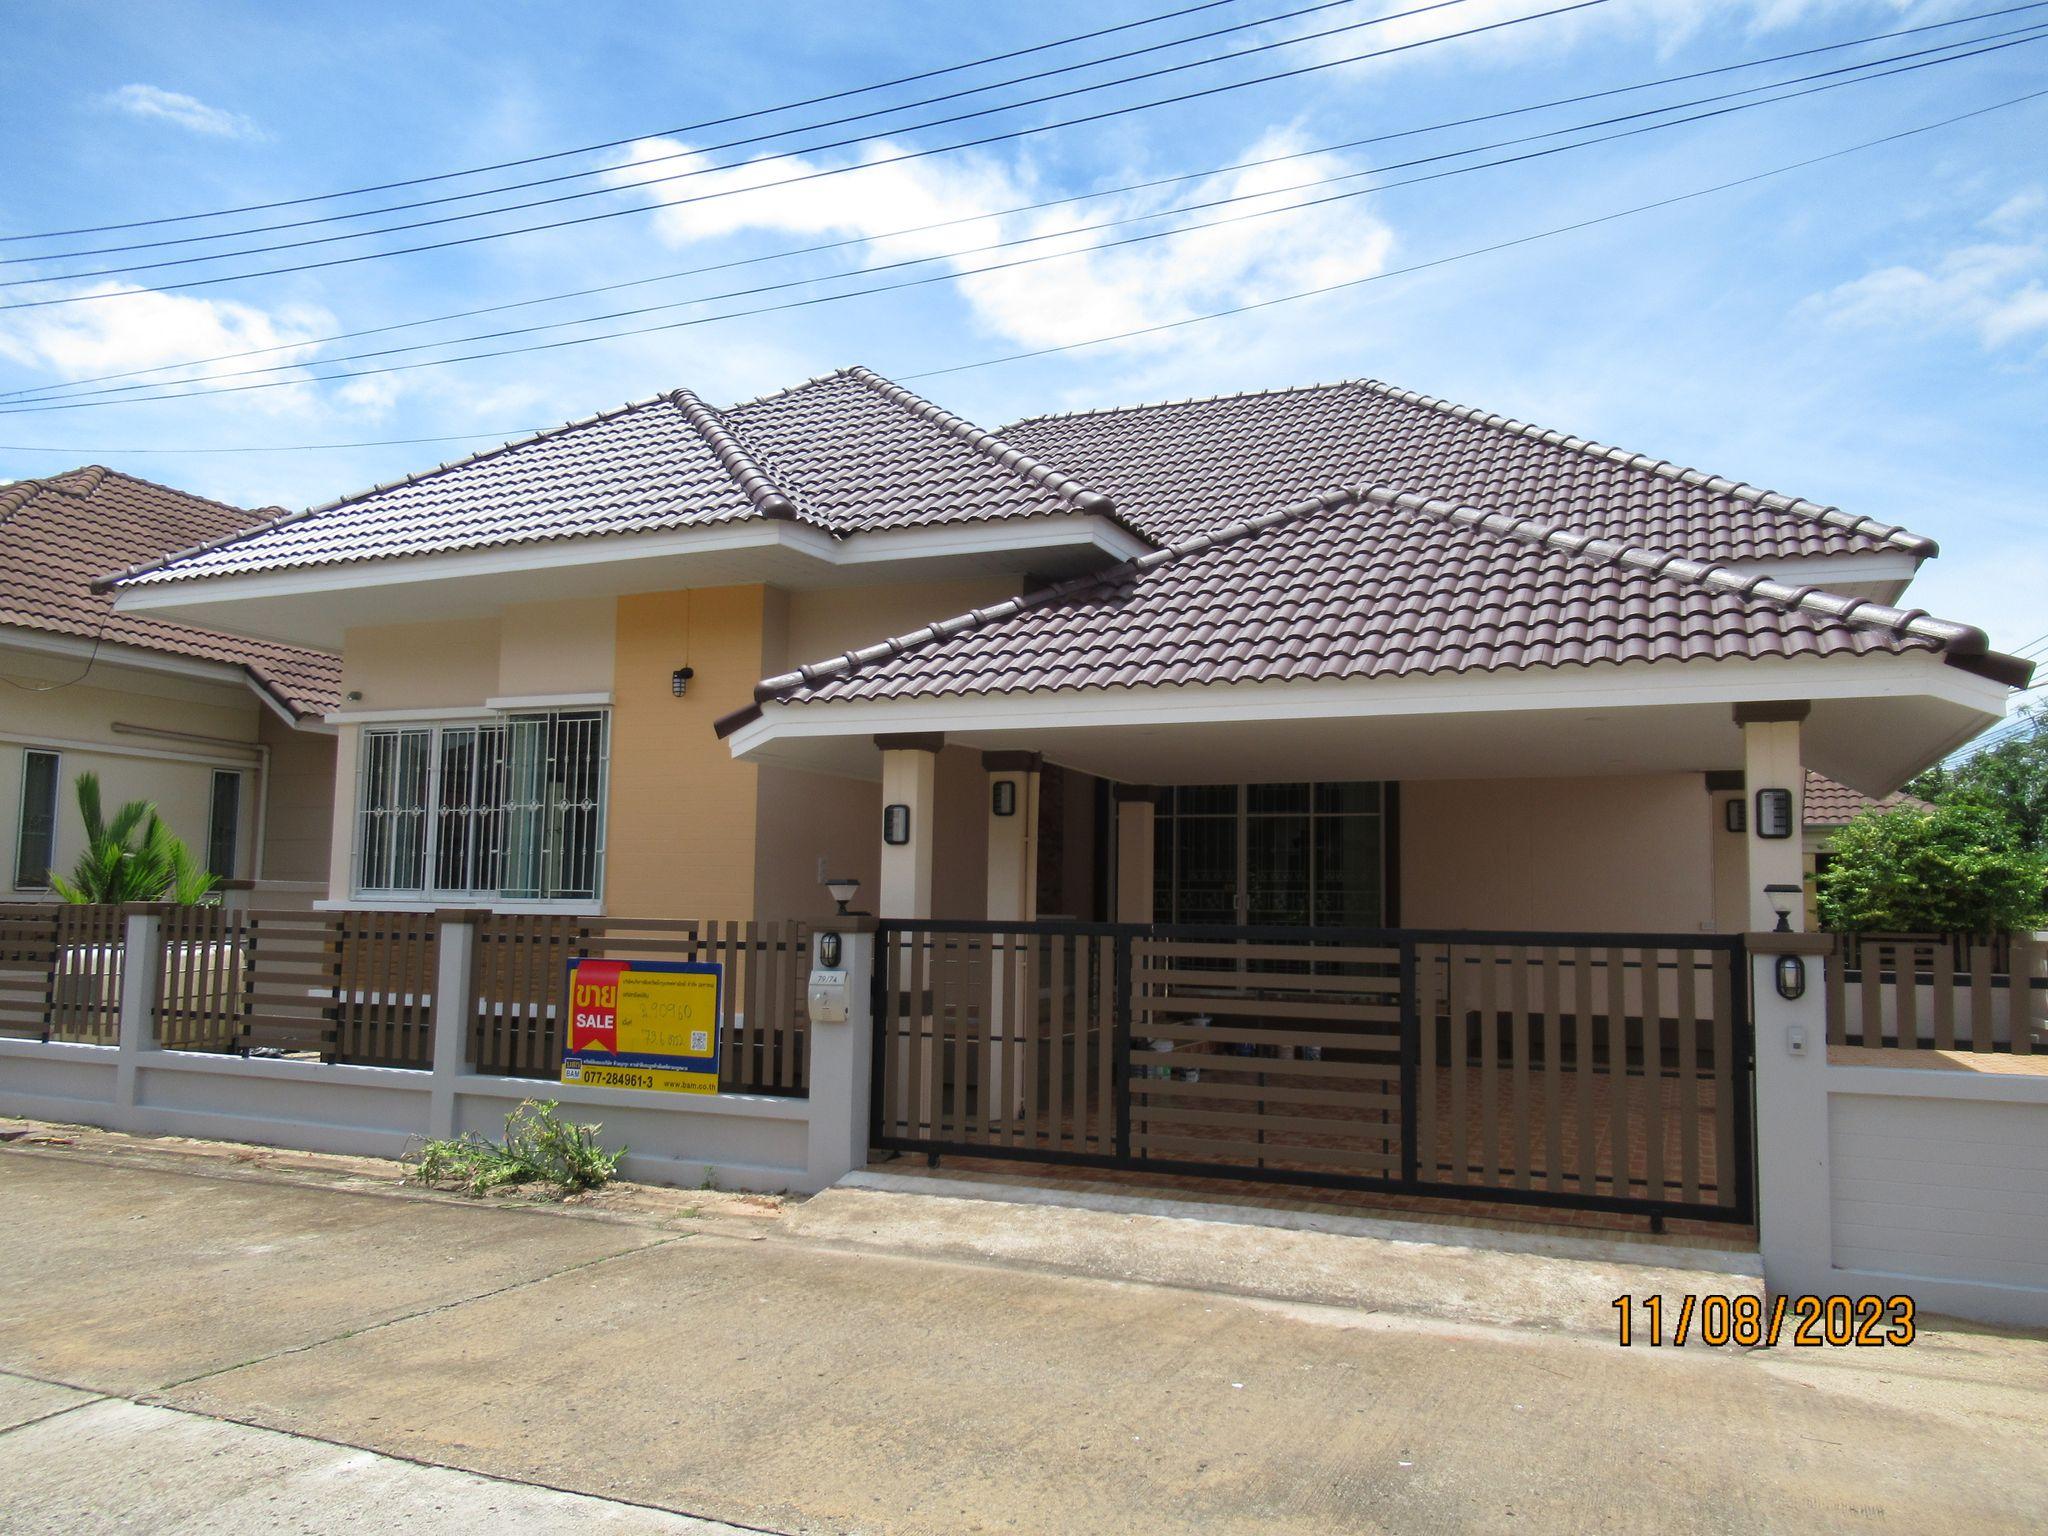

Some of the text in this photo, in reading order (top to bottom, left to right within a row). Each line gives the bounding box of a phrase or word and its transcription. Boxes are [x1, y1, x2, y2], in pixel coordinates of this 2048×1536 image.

[577, 984, 616, 1008] ขาย
[576, 1014, 614, 1030] SALE
[566, 1069, 580, 1077] BAM
[584, 1071, 653, 1088] 077-284961-3
[664, 1079, 716, 1091] www.bam.co.th
